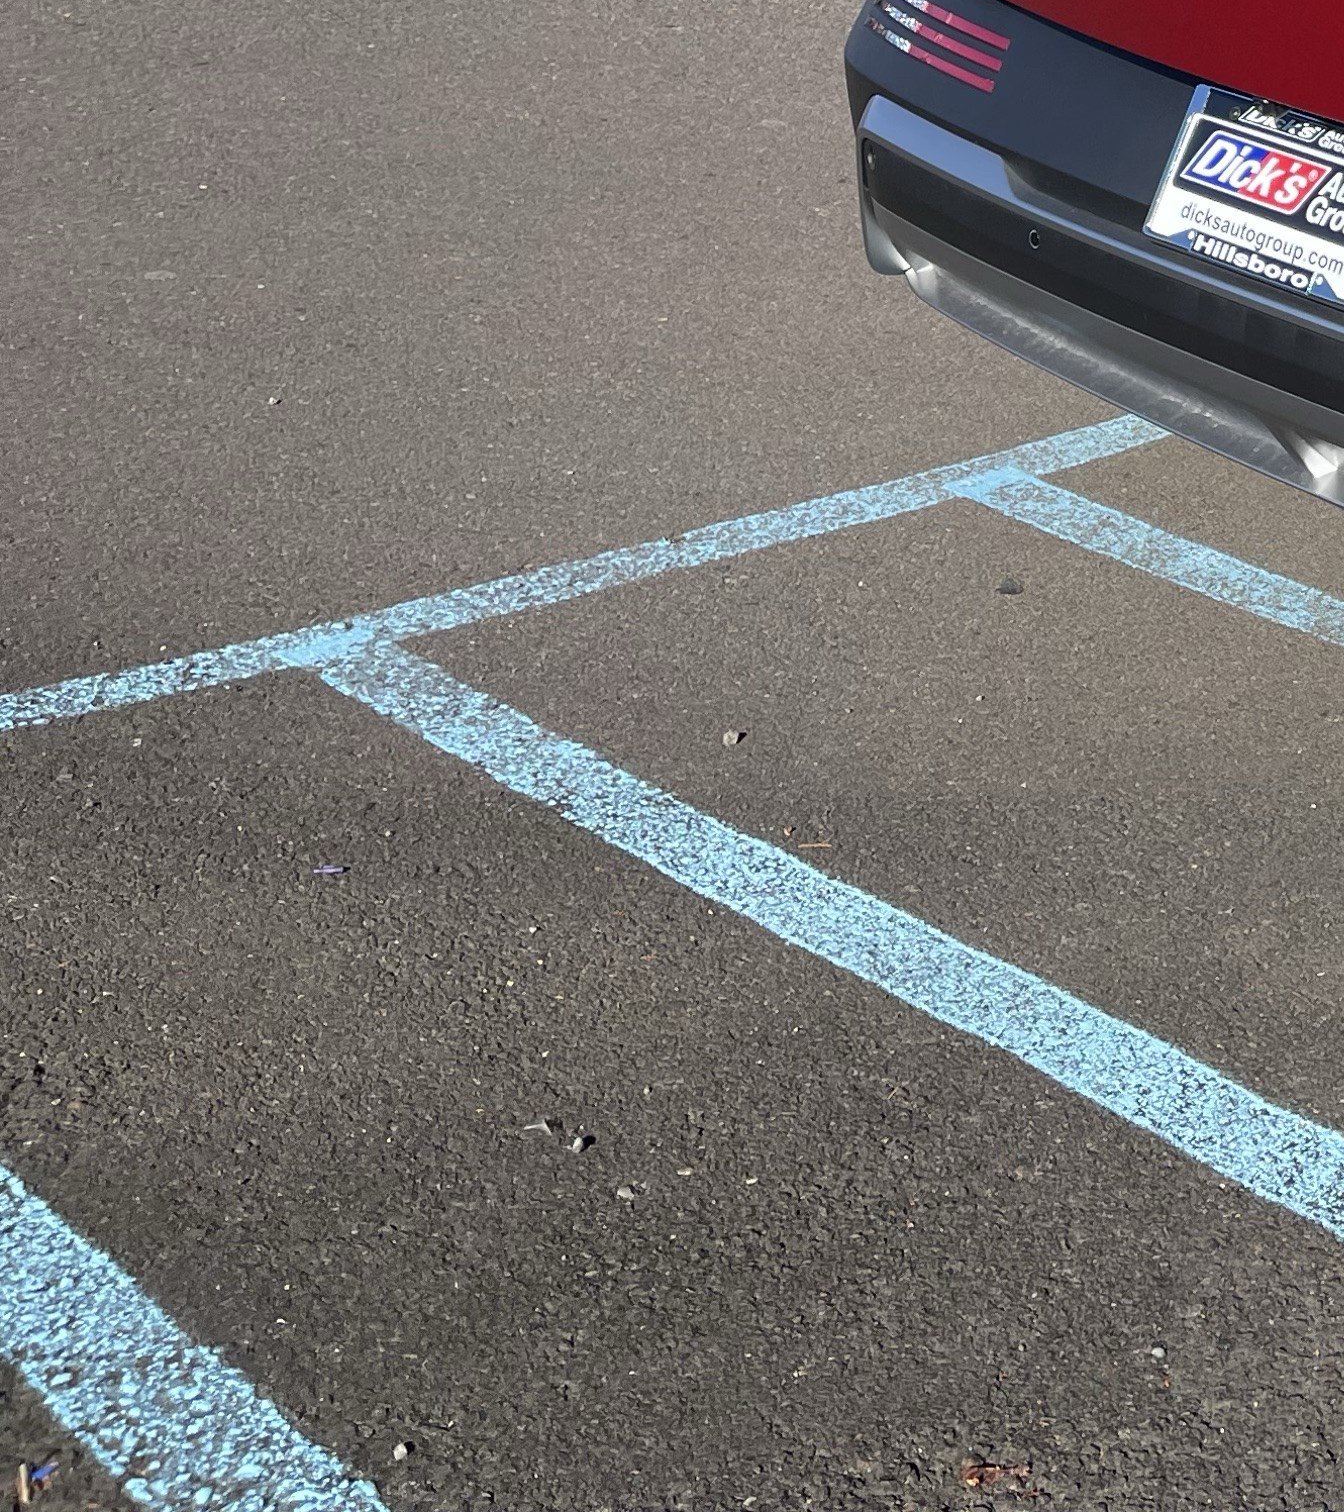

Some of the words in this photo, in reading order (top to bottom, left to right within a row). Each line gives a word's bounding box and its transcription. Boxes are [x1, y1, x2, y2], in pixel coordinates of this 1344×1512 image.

[1190, 138, 1307, 207] Dick's
[1180, 201, 1344, 276] dicksautogroup.com
[1191, 234, 1309, 290] Hillsboro
